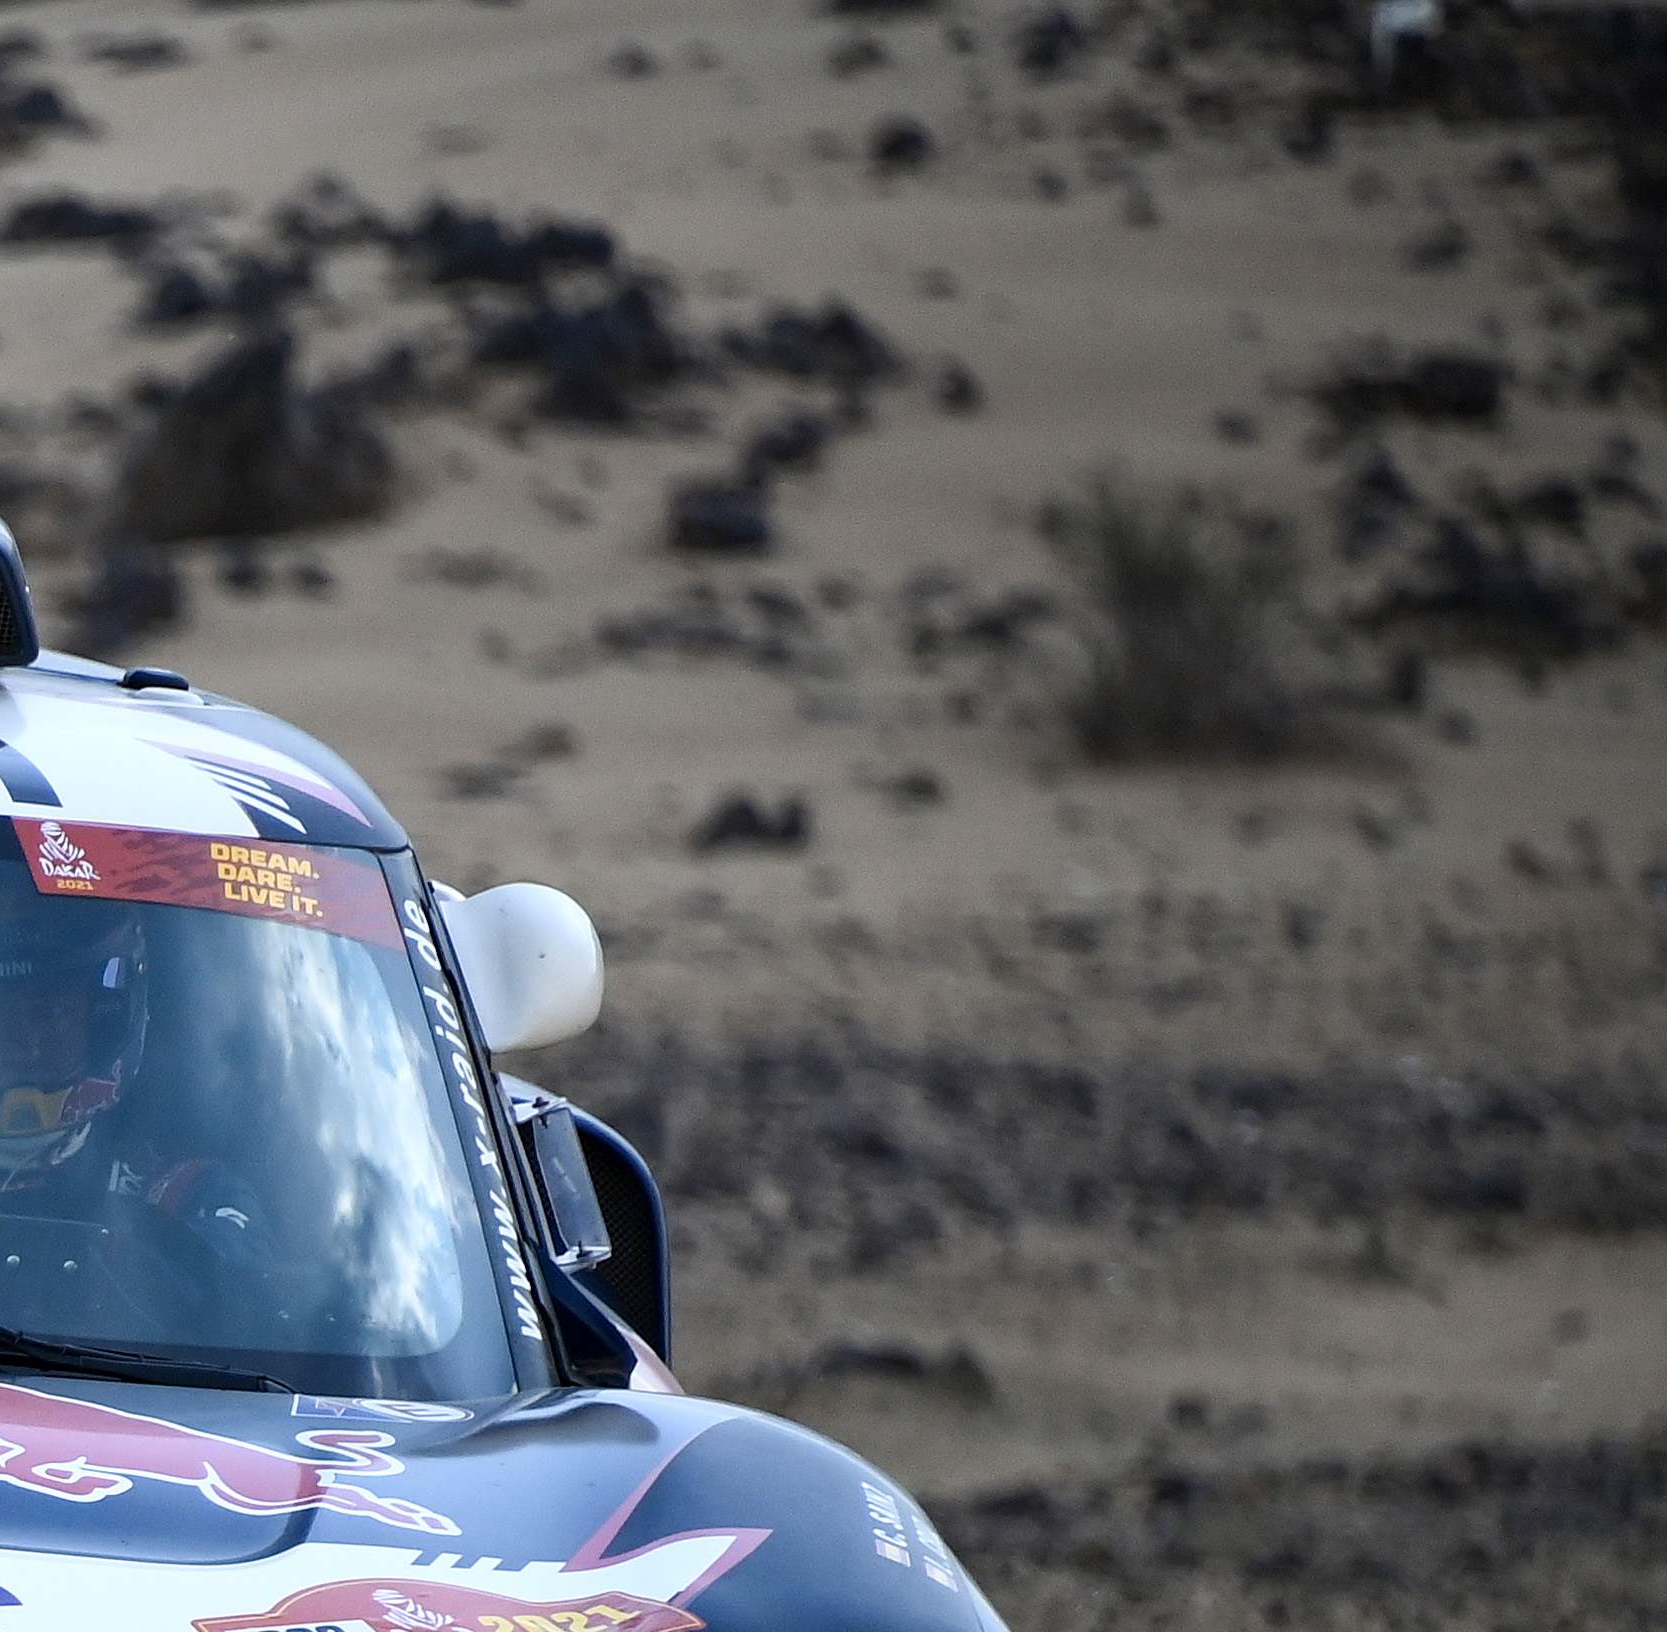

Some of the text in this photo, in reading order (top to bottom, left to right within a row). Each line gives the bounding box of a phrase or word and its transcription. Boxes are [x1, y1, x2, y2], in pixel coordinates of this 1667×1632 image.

[38, 857, 101, 881] DAKAR
[210, 842, 321, 879] DREAM.
[56, 879, 95, 891] 2021
[217, 862, 302, 894] DARE.
[224, 881, 324, 918] LIVE IT.
